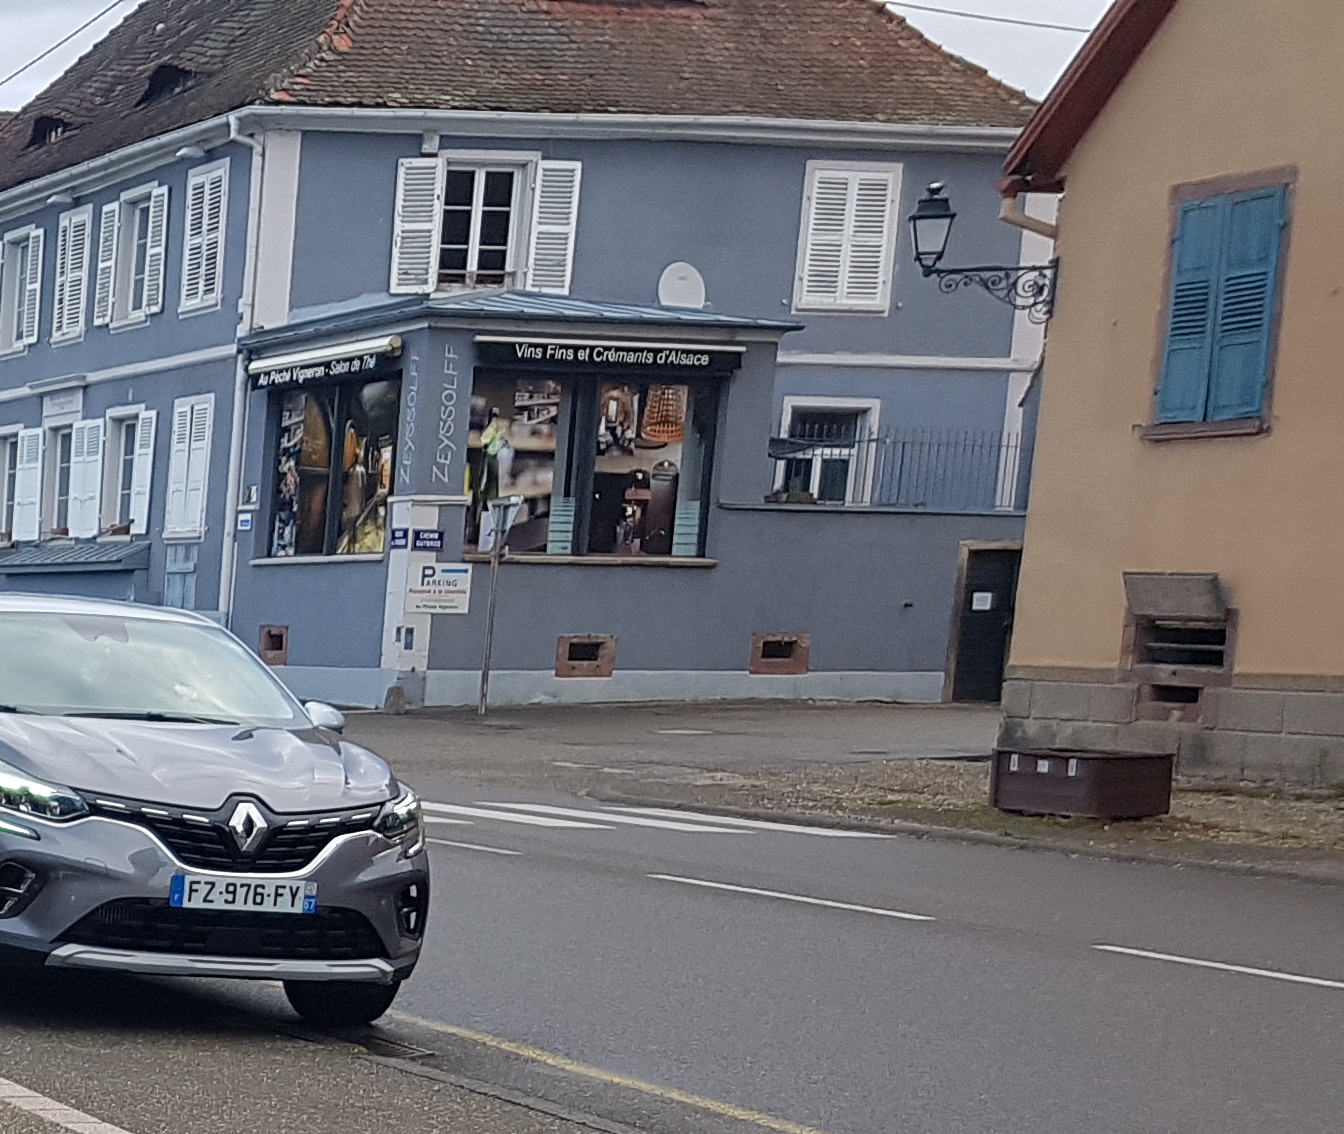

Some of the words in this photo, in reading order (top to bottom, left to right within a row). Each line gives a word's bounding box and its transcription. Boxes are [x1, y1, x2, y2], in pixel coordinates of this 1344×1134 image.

[515, 343, 543, 359] Vins
[546, 345, 574, 361] Fins
[577, 347, 590, 362] et
[593, 347, 654, 365] Crémants
[656, 350, 710, 366] d'Alsace
[431, 344, 459, 483] ZEYSSOLFF
[420, 565, 458, 587] PARKING
[187, 880, 302, 908] FZ-976-FY
